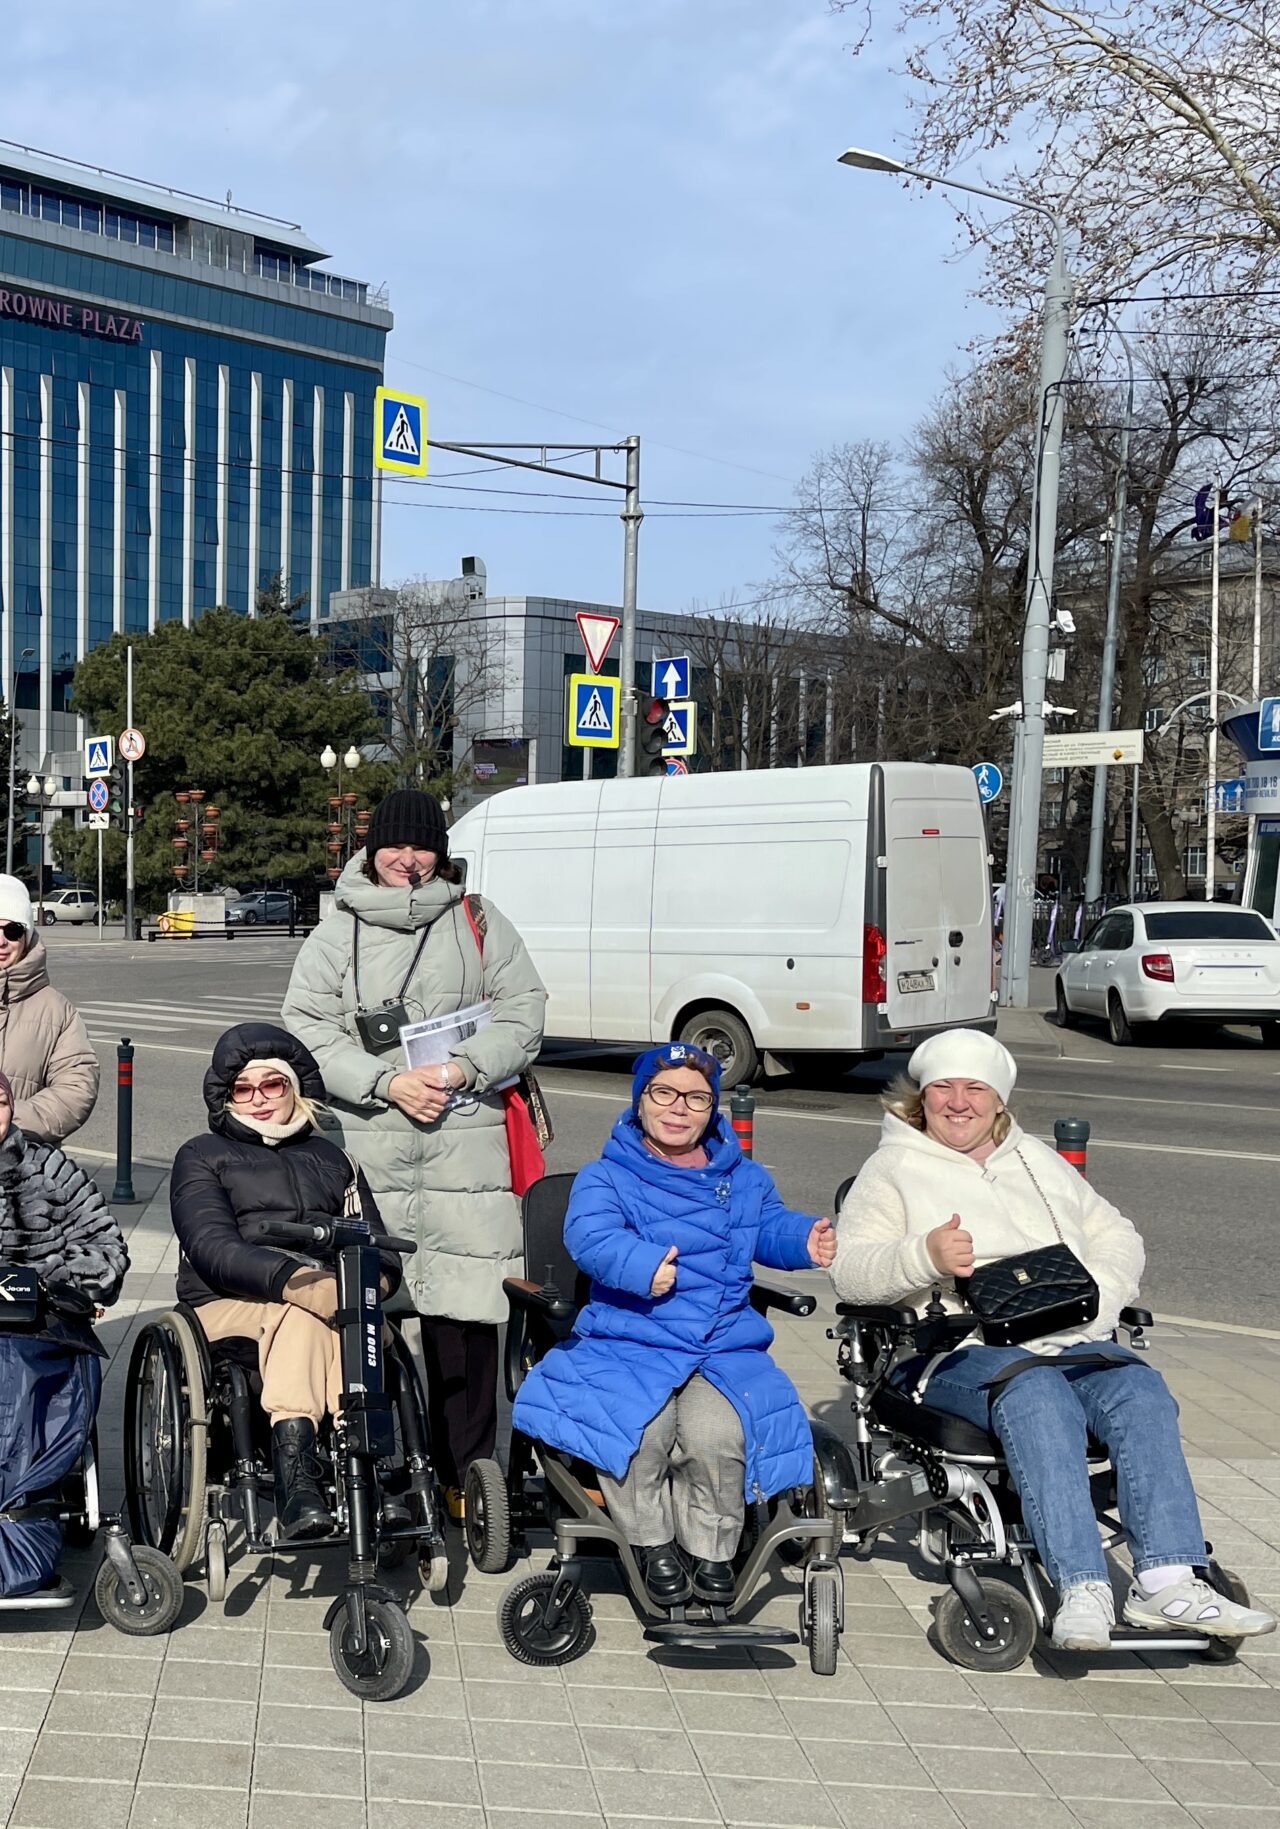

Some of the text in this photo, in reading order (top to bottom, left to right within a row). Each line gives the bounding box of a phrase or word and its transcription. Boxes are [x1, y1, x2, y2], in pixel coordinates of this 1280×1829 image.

[81, 308, 144, 341] PLAZA
[366, 1323, 377, 1367] M 0013
